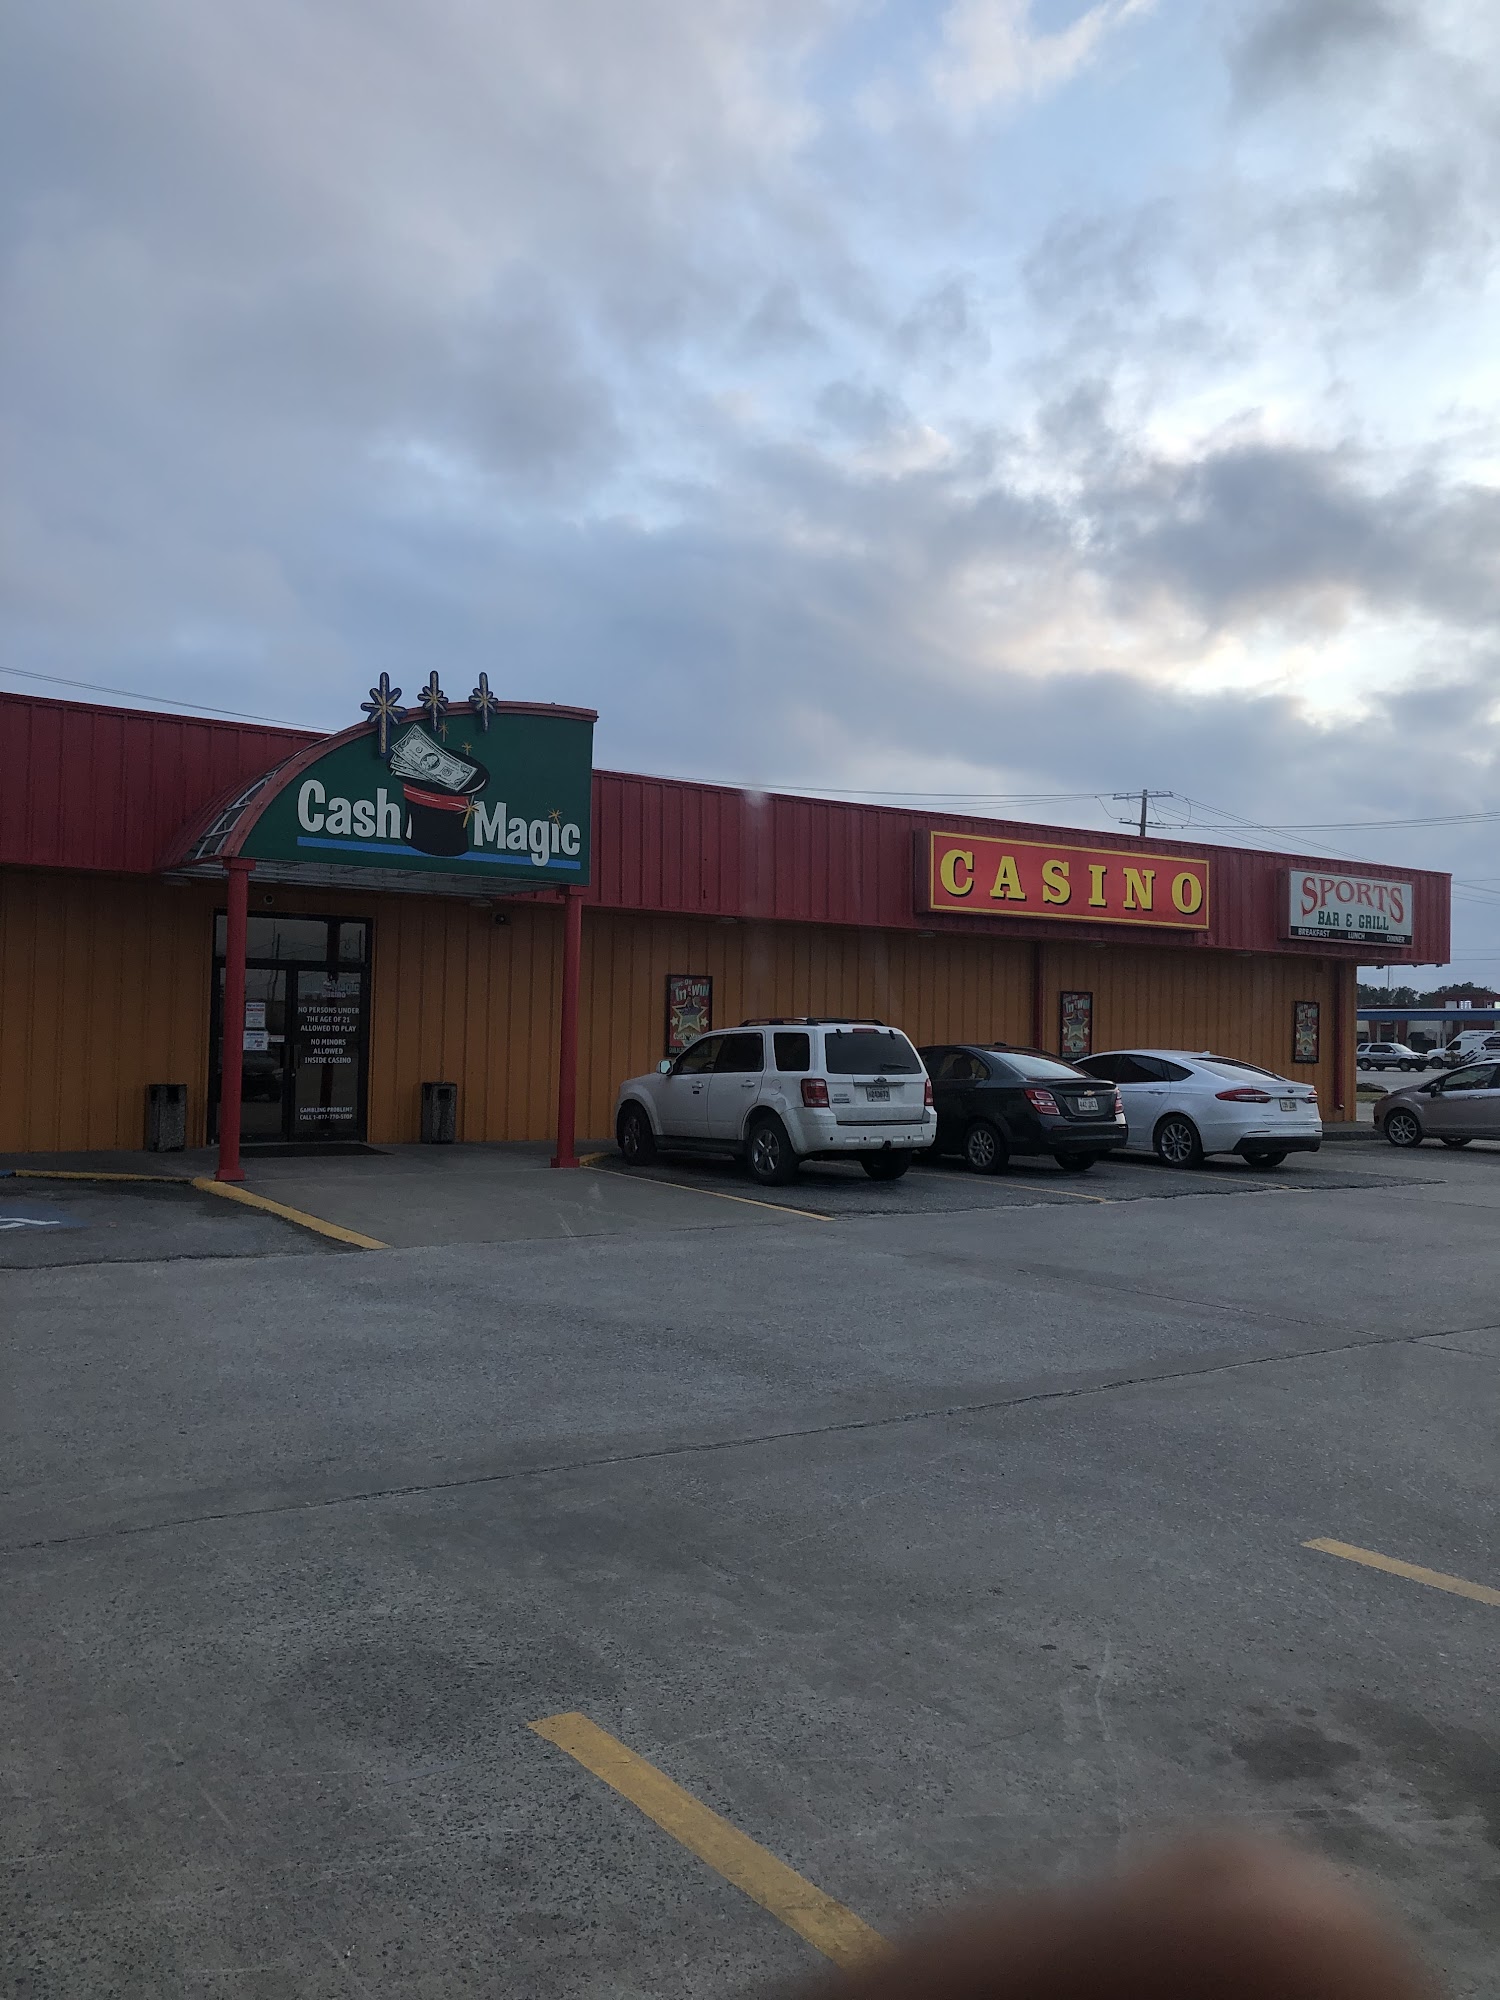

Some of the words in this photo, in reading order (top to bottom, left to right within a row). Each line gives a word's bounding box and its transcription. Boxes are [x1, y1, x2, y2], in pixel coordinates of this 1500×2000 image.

[298, 779, 401, 839] Cash
[473, 800, 581, 866] Magic
[940, 849, 1203, 914] CASINO
[1301, 876, 1404, 924] SPORTS
[1298, 928, 1331, 938] BREAKFAST
[1347, 932, 1366, 940] LUNCH
[1317, 910, 1340, 927] BAR
[1358, 914, 1389, 931] GRILL
[321, 1038, 346, 1046] MINORS
